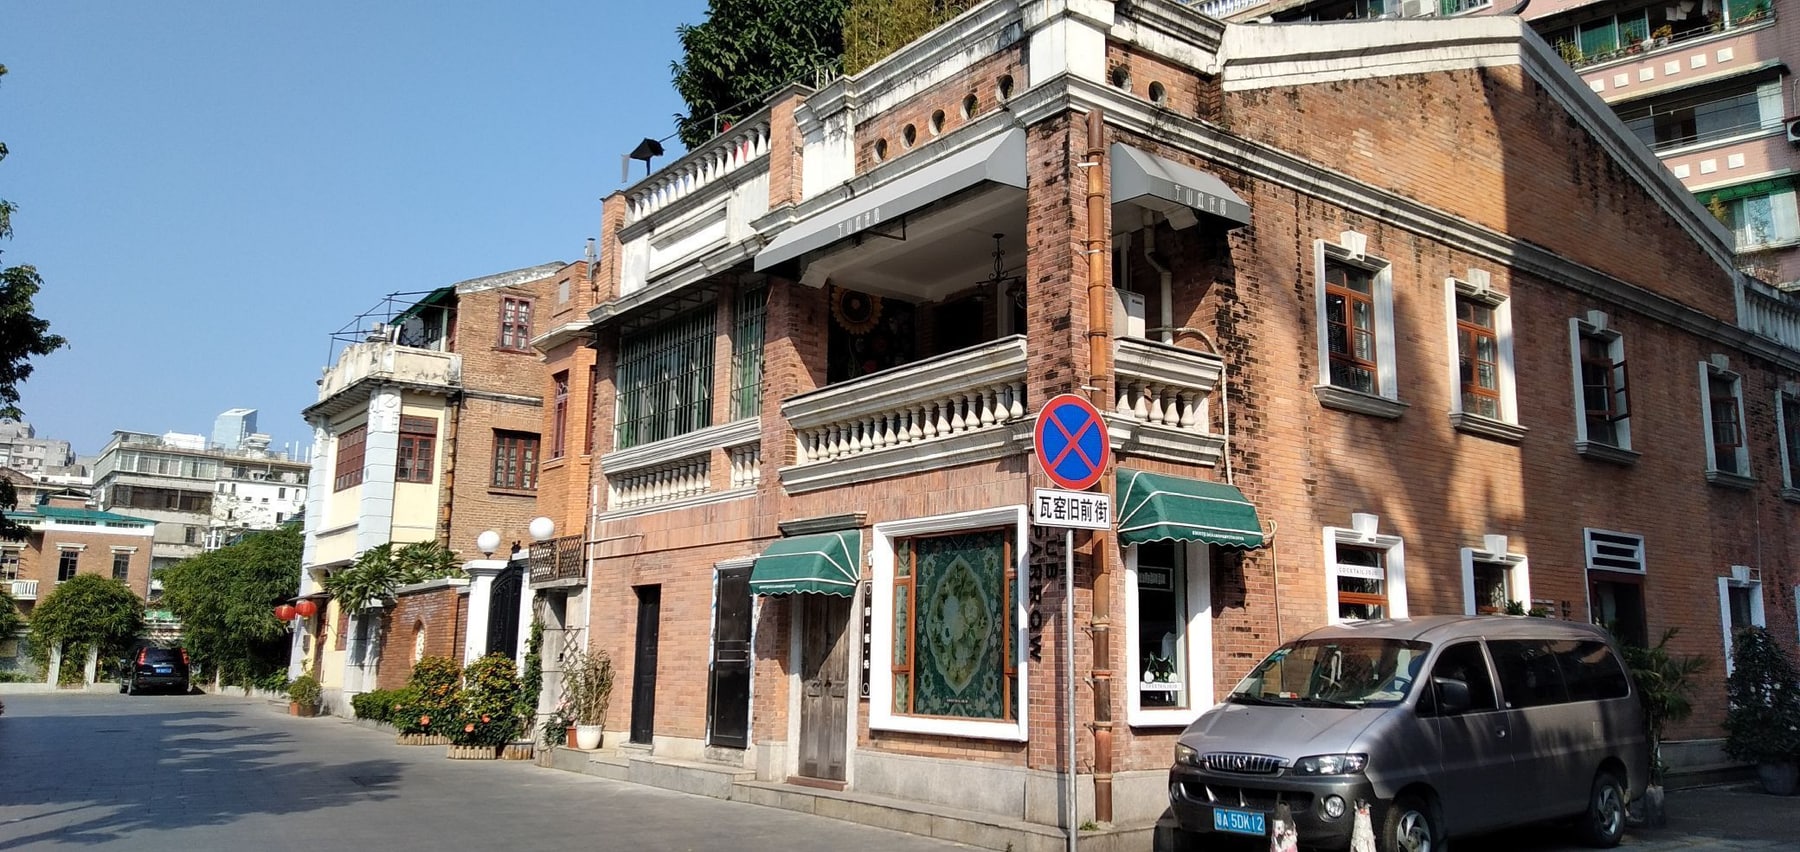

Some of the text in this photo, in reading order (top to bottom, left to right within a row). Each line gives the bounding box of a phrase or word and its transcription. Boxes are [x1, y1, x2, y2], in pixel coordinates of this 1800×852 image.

[1039, 496, 1108, 523] 瓦窑旧前街
